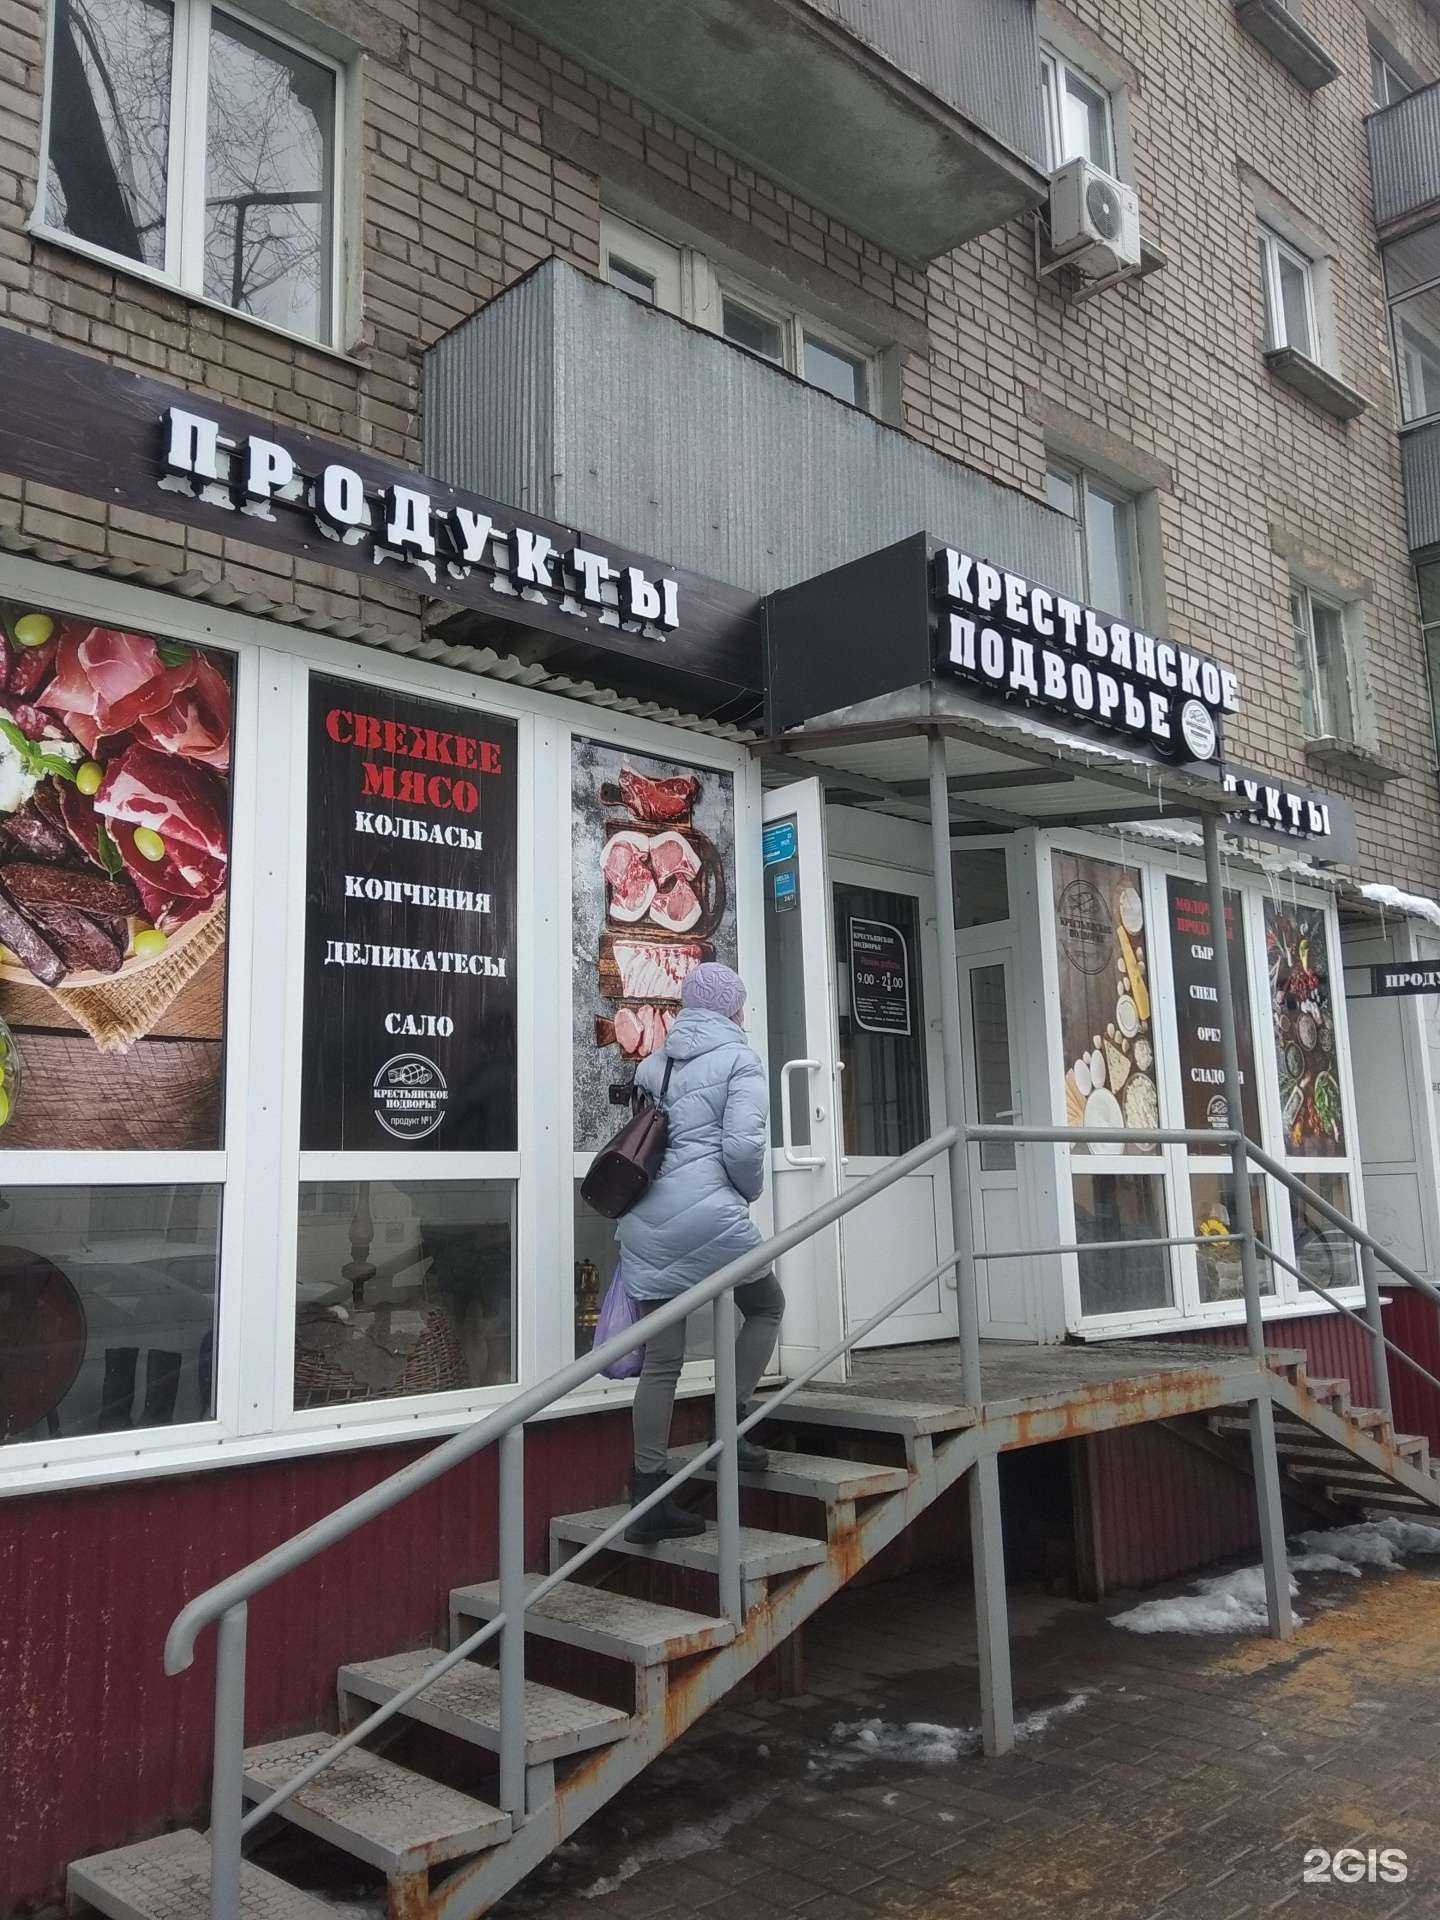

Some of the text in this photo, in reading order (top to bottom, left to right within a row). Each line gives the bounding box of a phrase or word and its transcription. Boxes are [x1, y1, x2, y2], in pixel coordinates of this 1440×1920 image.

[168, 407, 680, 628] ПРОДУКТЫ
[946, 547, 1240, 713] КРЕСТЬЯНСКОЕ
[949, 613, 1171, 739] ПОДВОРЬЕ
[325, 708, 503, 775] СВЕЖЕЕ
[361, 761, 480, 814] МЯСО
[354, 810, 484, 851] КОЛБАСЫ
[344, 875, 492, 914] КОПЧЕНИЯ
[324, 940, 507, 978] ДЕЛИКАТЕСЫ
[1191, 944, 1214, 960] СЫР
[856, 972, 875, 985] 9.00
[1189, 985, 1218, 1002] СПЕЦ
[384, 1012, 455, 1037] САЛО
[373, 1089, 448, 1099] КРЕСТЬЯНСКОЕ
[386, 1099, 437, 1110] ПОДВОРЬЕ
